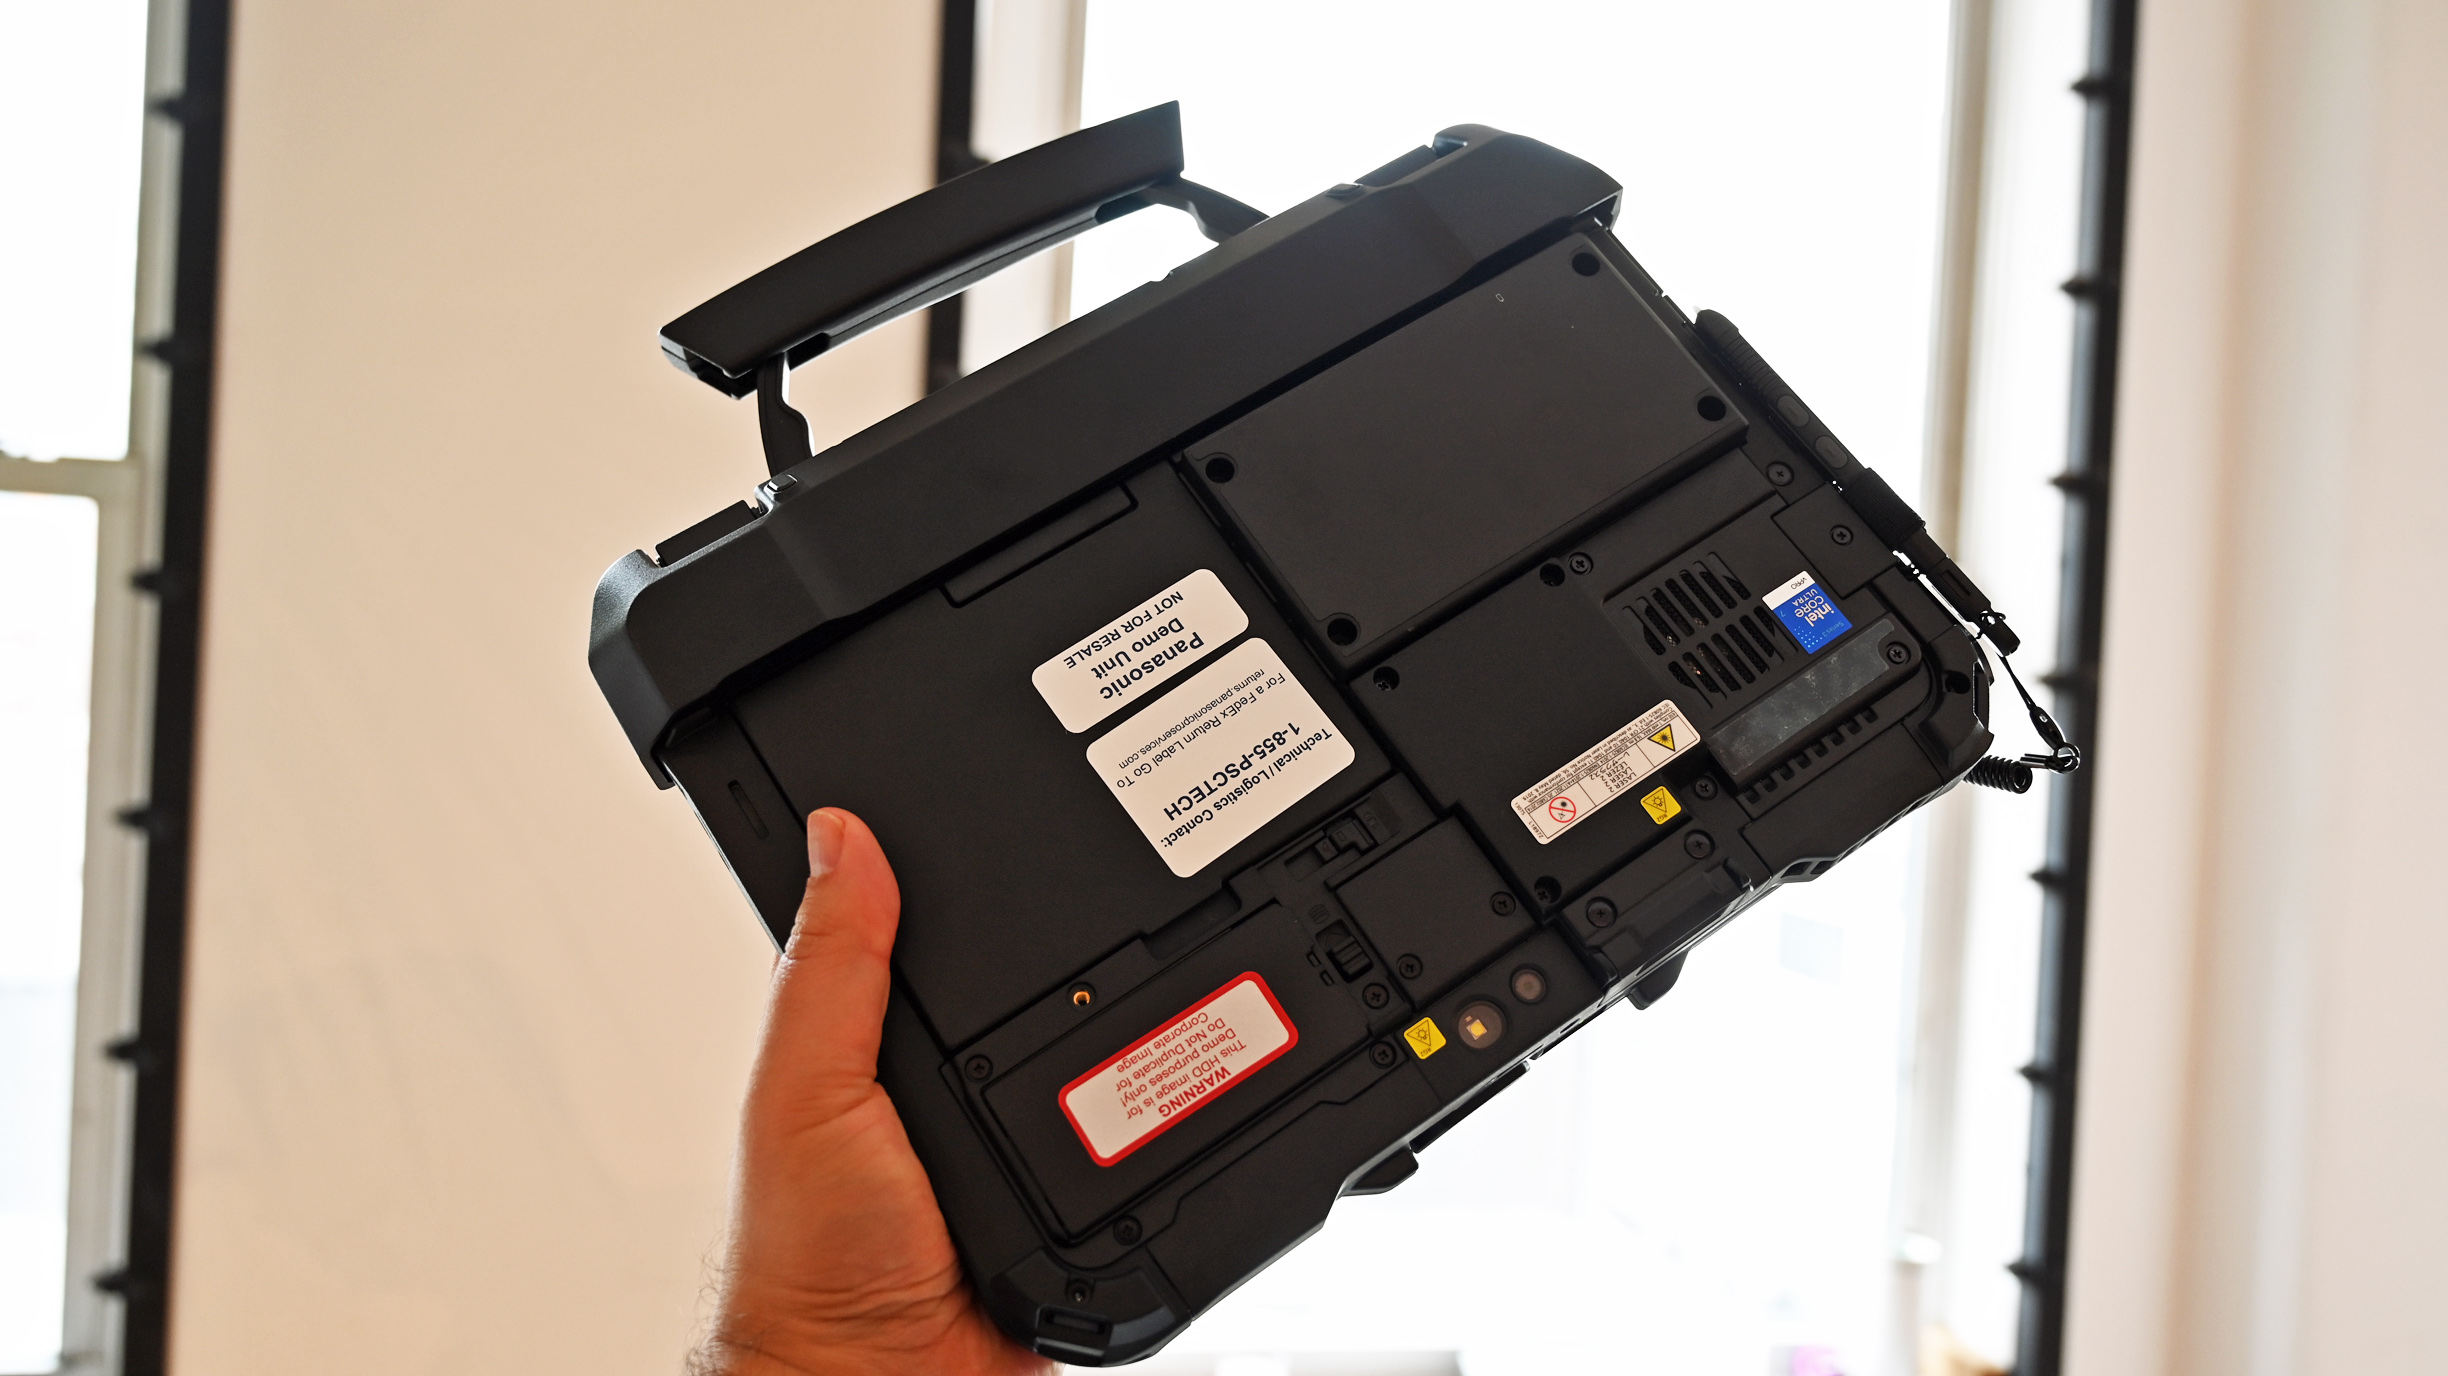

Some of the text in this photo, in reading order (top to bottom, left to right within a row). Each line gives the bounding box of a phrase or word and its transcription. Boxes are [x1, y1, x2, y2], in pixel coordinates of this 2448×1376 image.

[1791, 588, 1818, 607] ULTRA
[1803, 602, 1835, 627] intel
[1826, 620, 1844, 633] Series
[1062, 590, 1184, 669] NOT FOR RESALE
[1090, 616, 1185, 680] Demo Unit
[1099, 630, 1205, 700] Panasonic
[1265, 671, 1286, 690] For
[1219, 691, 1257, 719] FedEx
[1117, 668, 1265, 769] returns.panasonicproservices.com
[1182, 715, 1222, 744] Return
[1272, 727, 1333, 772] Technical
[1606, 730, 1627, 745] described
[1151, 740, 1185, 767] Label
[1576, 753, 1591, 765] Notice
[1132, 762, 1152, 777] Go
[1162, 722, 1300, 822] 1-855-PSCTECH
[1572, 762, 1587, 773] except
[1605, 760, 1628, 778] LÉZER
[1609, 766, 1633, 784] LÁSER
[1613, 771, 1637, 789] LASER
[1116, 775, 1136, 788] To
[1212, 769, 1271, 811] Logistics
[1537, 776, 1566, 796] conformance
[1160, 808, 1214, 848] Contact:
[1115, 1011, 1209, 1073] Corporate Image
[1115, 1017, 1226, 1092] Do Not Duplicate for
[1219, 1039, 1247, 1058] This
[1119, 1027, 1237, 1108] Demo purposes only!
[1191, 1054, 1221, 1078] HDD
[1154, 1073, 1192, 1100] image
[1157, 1065, 1232, 1118] WARNING
[1126, 1104, 1144, 1120] for
